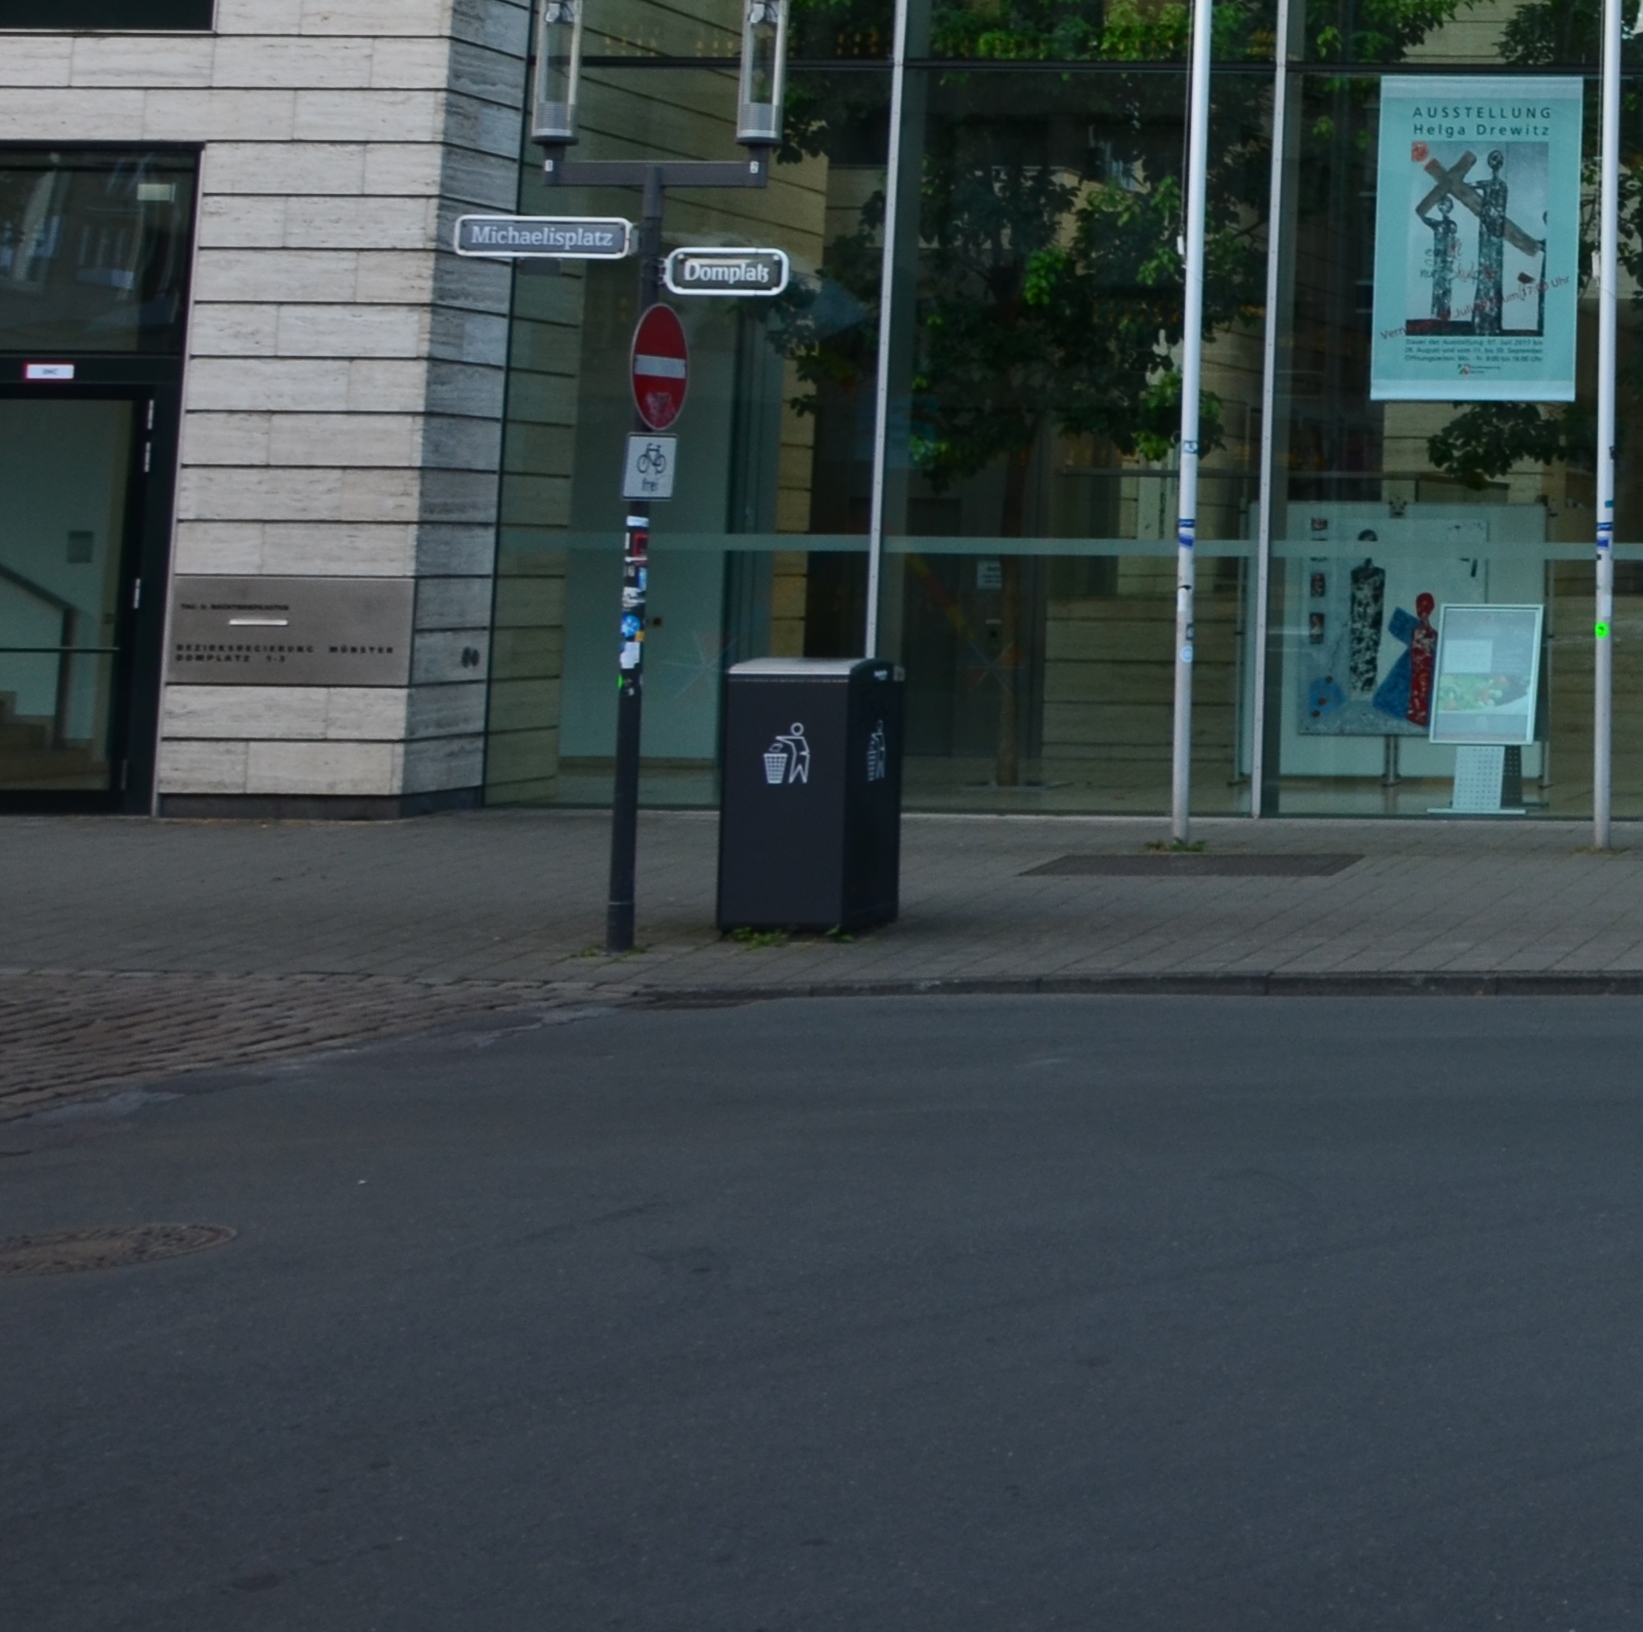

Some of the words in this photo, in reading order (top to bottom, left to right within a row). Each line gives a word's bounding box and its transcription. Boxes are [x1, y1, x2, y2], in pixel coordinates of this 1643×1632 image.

[1412, 106, 1551, 119] AUSSTELLUNG
[1413, 123, 1466, 138] Helga
[1476, 123, 1549, 136] Drewitz
[471, 225, 613, 250] Michaelisplatz
[684, 261, 769, 283] Domplatz
[642, 477, 659, 492] frei
